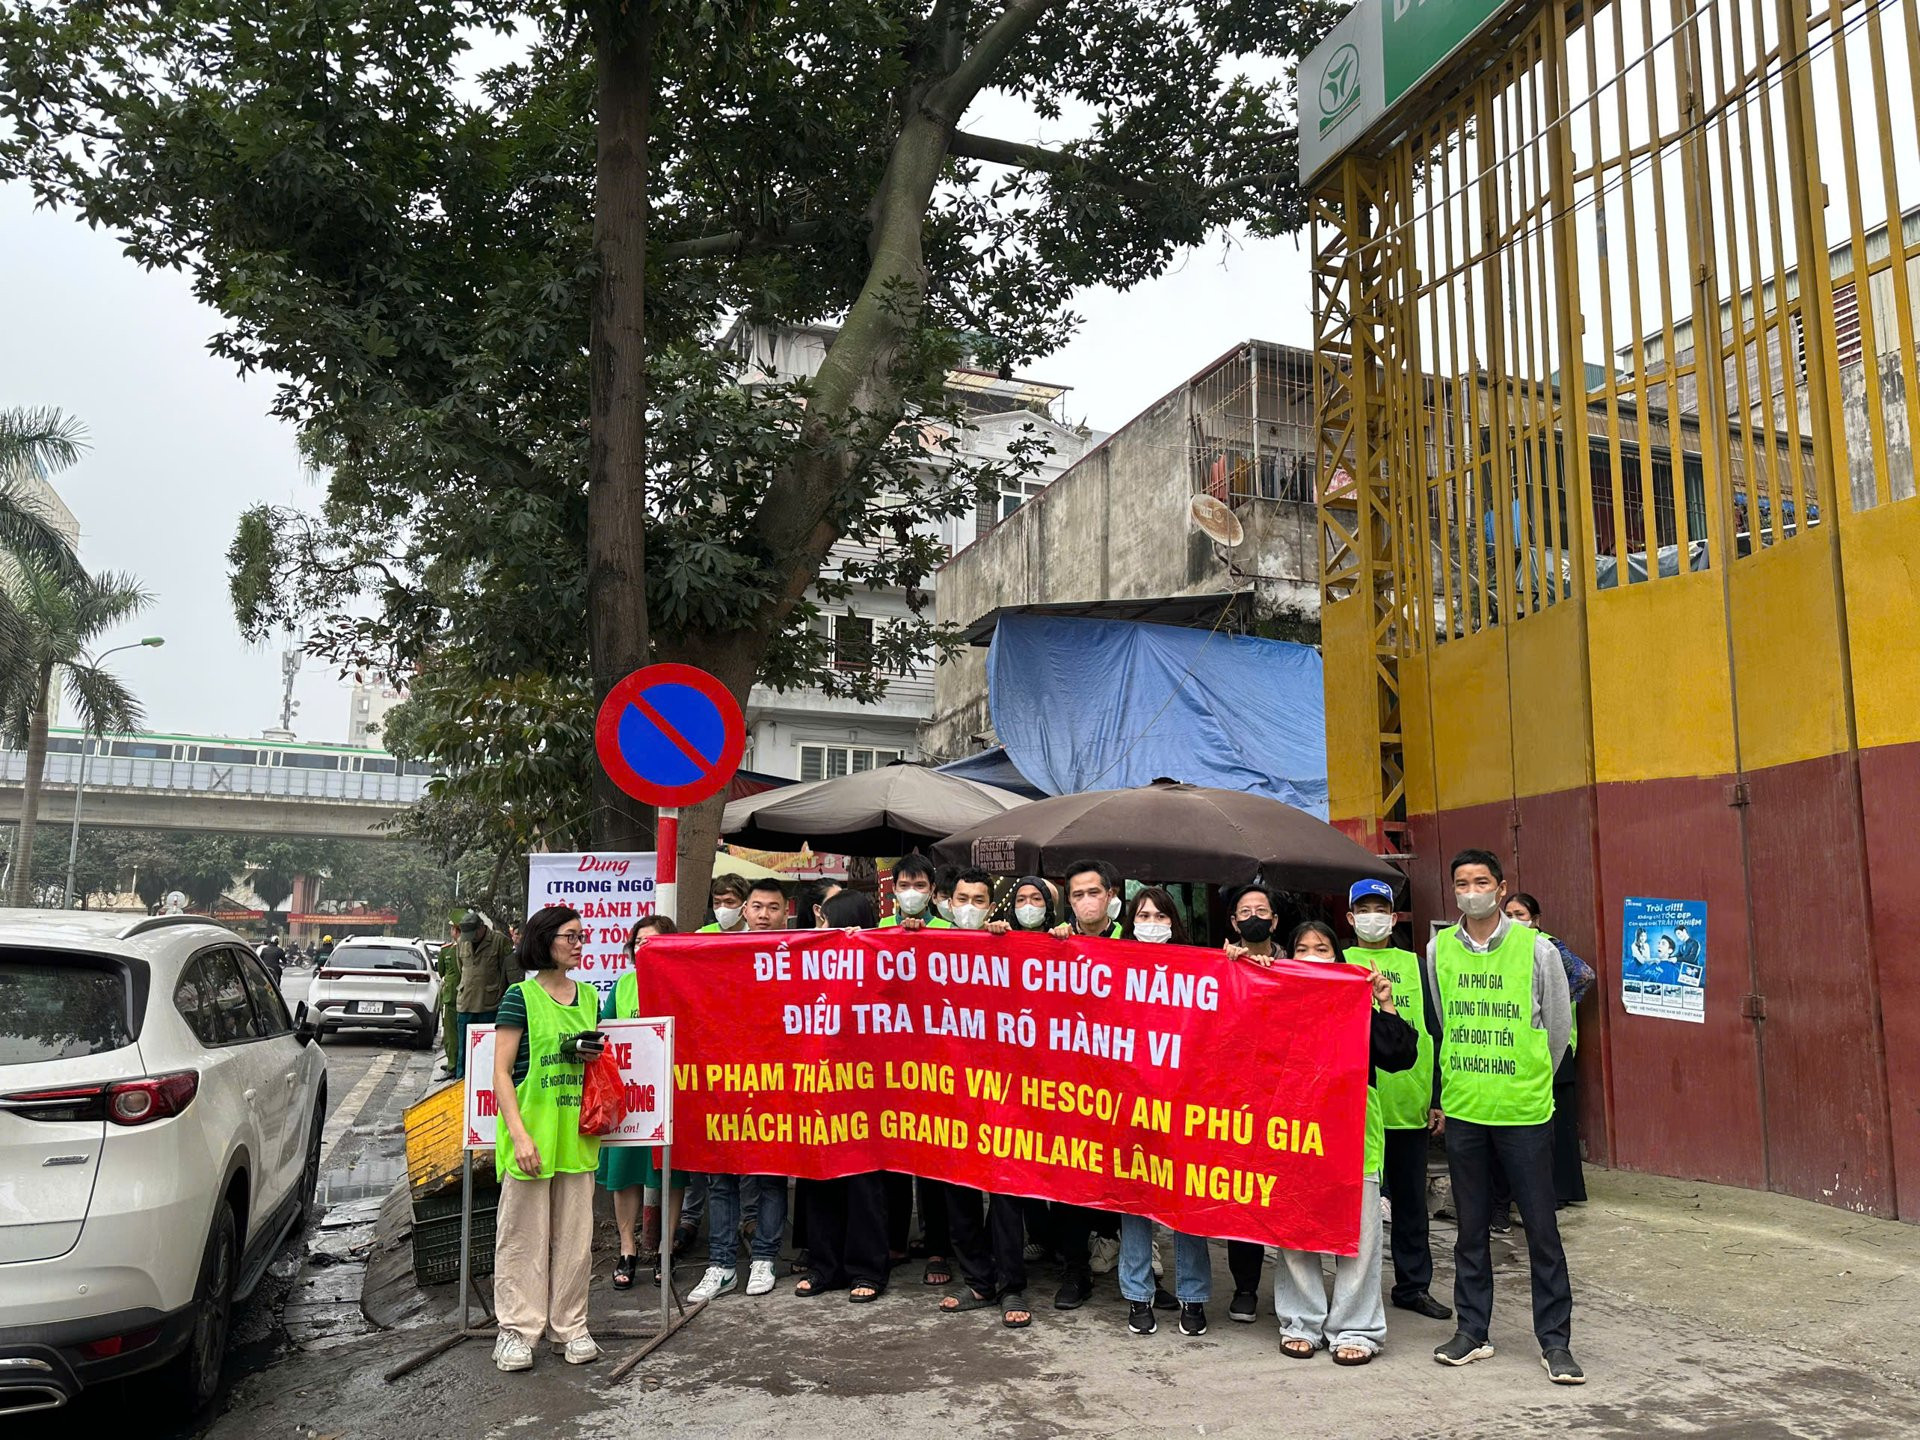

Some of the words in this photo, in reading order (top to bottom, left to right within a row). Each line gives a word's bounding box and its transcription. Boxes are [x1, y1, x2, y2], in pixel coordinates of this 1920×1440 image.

[578, 855, 630, 876] Dung
[547, 880, 611, 894] (TRONG
[600, 954, 628, 974] VỊT
[754, 942, 791, 981] ĐỀ
[802, 949, 863, 987] NGHỊ
[877, 947, 916, 981] CƠ
[929, 952, 1010, 988] QUAN
[1022, 955, 1112, 998] CHỨC
[1125, 964, 1219, 1011] NĂNG
[1458, 973, 1469, 988] AN
[1471, 971, 1487, 989] PHÚ
[1489, 974, 1503, 989] GIA
[1477, 998, 1489, 1016] TÍN
[783, 993, 840, 1035] ĐIỀU
[852, 1003, 913, 1035] TRA
[924, 999, 986, 1040] LÀM
[997, 1009, 1037, 1048] RÕ
[1049, 1013, 1135, 1062] HÀNH
[1148, 1031, 1181, 1068] VI
[1450, 1024, 1470, 1043] CHIẾM
[1471, 1029, 1492, 1047] ĐOẠT
[1494, 1027, 1514, 1047] TIỀN
[615, 1043, 632, 1070] XE
[1463, 1054, 1490, 1073] KHÁCH
[1492, 1056, 1516, 1075] HÀNG
[673, 1064, 698, 1091] VI
[707, 1063, 784, 1098] PHẠM
[793, 1059, 873, 1093] THĂNG
[886, 1061, 954, 1095] LONG
[965, 1067, 1012, 1105] VN/
[1022, 1075, 1123, 1125] HESCO/
[1130, 1097, 1171, 1134] AN
[1185, 1104, 1253, 1145] PHÚ
[1267, 1116, 1324, 1156] GIA
[706, 1107, 792, 1142] KHÁCH
[799, 1109, 869, 1145] HÀNG
[880, 1110, 968, 1150] GRAND
[977, 1123, 1103, 1174] SUNLAKE
[1114, 1144, 1173, 1190] LÂM
[1185, 1163, 1277, 1207] NGUY
